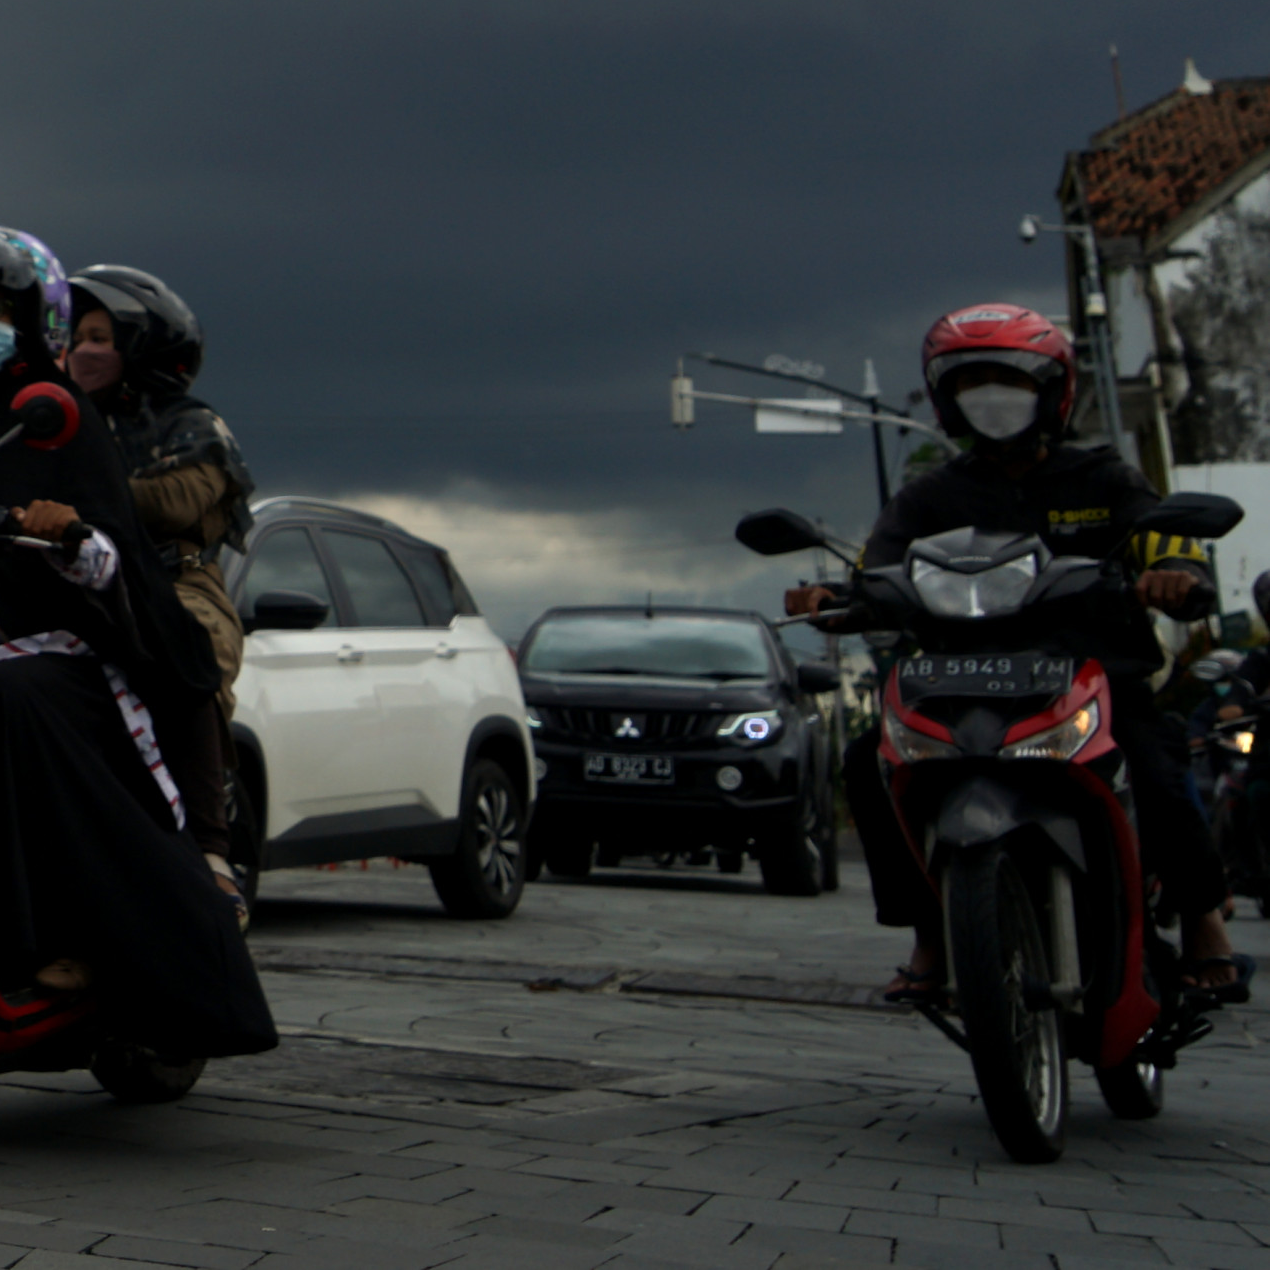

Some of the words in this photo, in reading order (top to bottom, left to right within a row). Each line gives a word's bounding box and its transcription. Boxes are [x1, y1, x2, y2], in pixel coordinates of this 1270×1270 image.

[901, 659, 934, 677] AB
[945, 657, 1013, 676] 5949
[1032, 659, 1066, 675] YM
